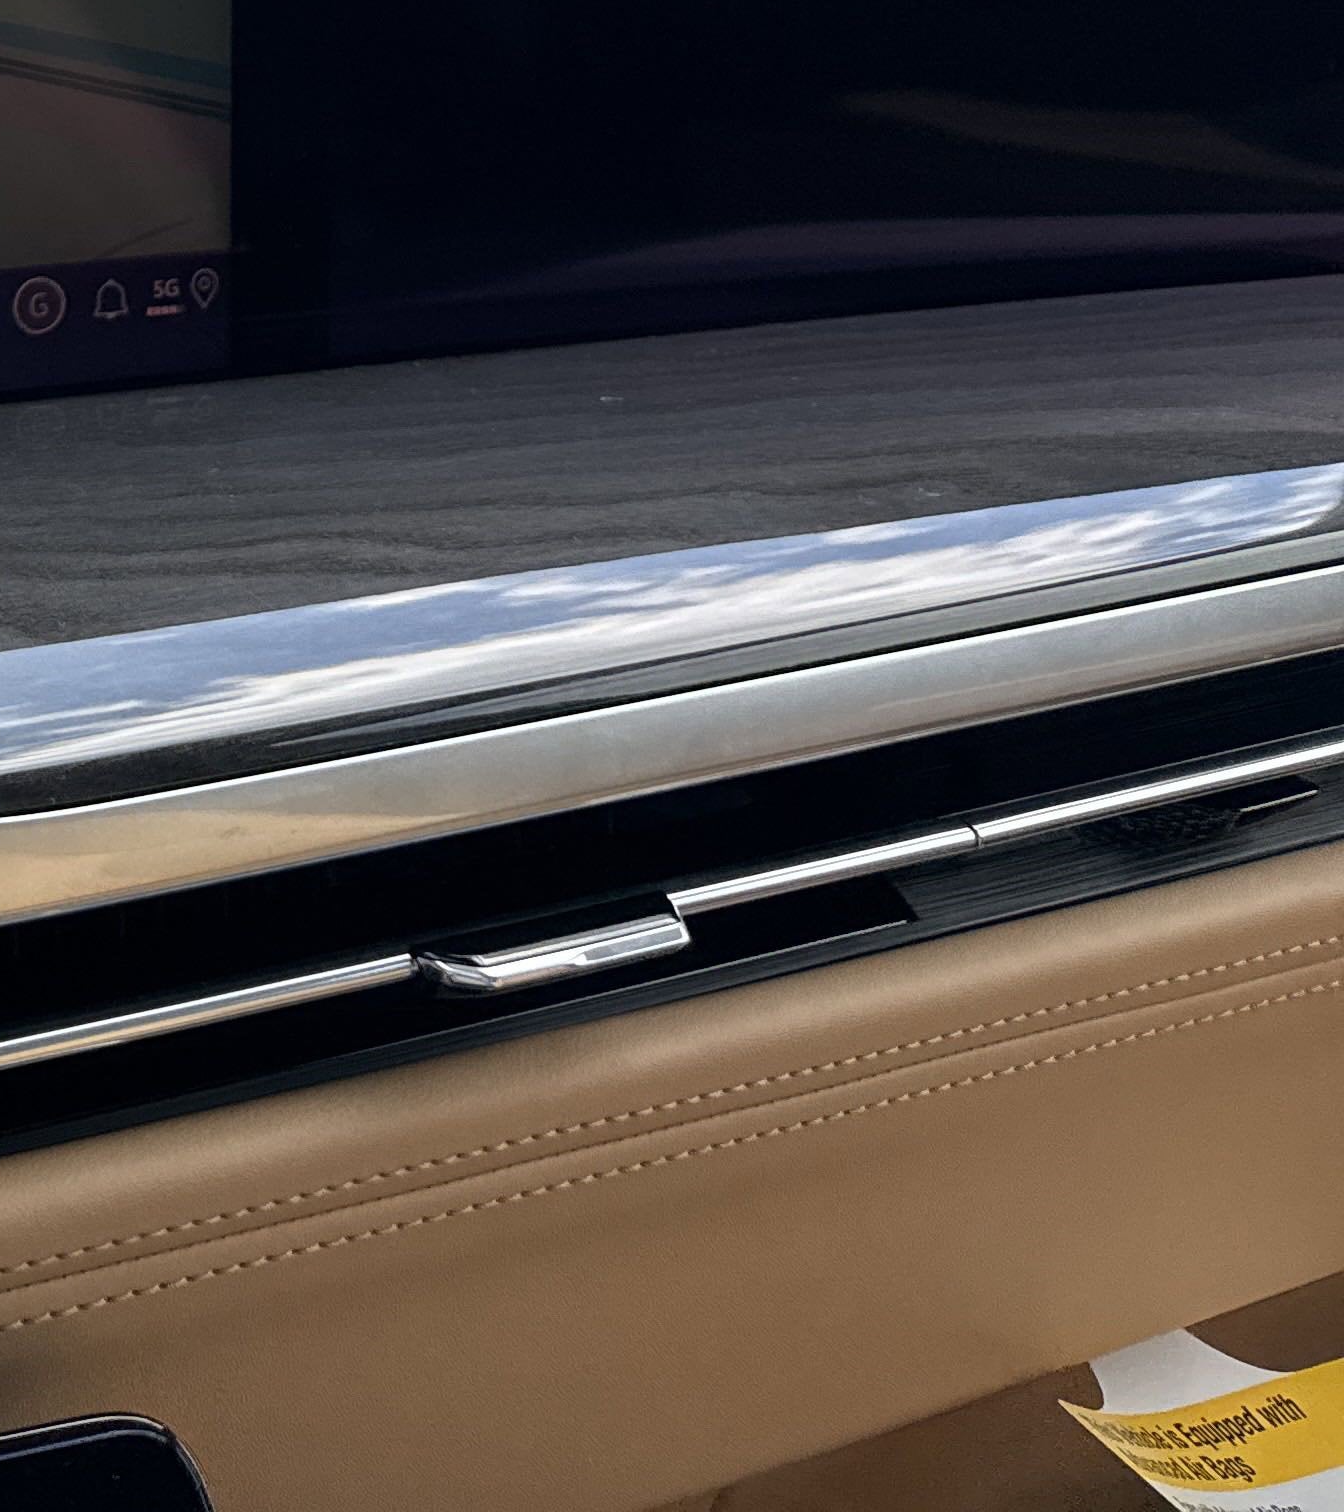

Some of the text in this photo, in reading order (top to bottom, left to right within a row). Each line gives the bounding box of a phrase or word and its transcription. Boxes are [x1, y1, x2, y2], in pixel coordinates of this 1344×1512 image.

[154, 279, 179, 298] 5G
[29, 292, 48, 318] G
[1178, 1405, 1264, 1451] Equipped
[1257, 1393, 1307, 1428] with
[1203, 1452, 1256, 1484] Bags
